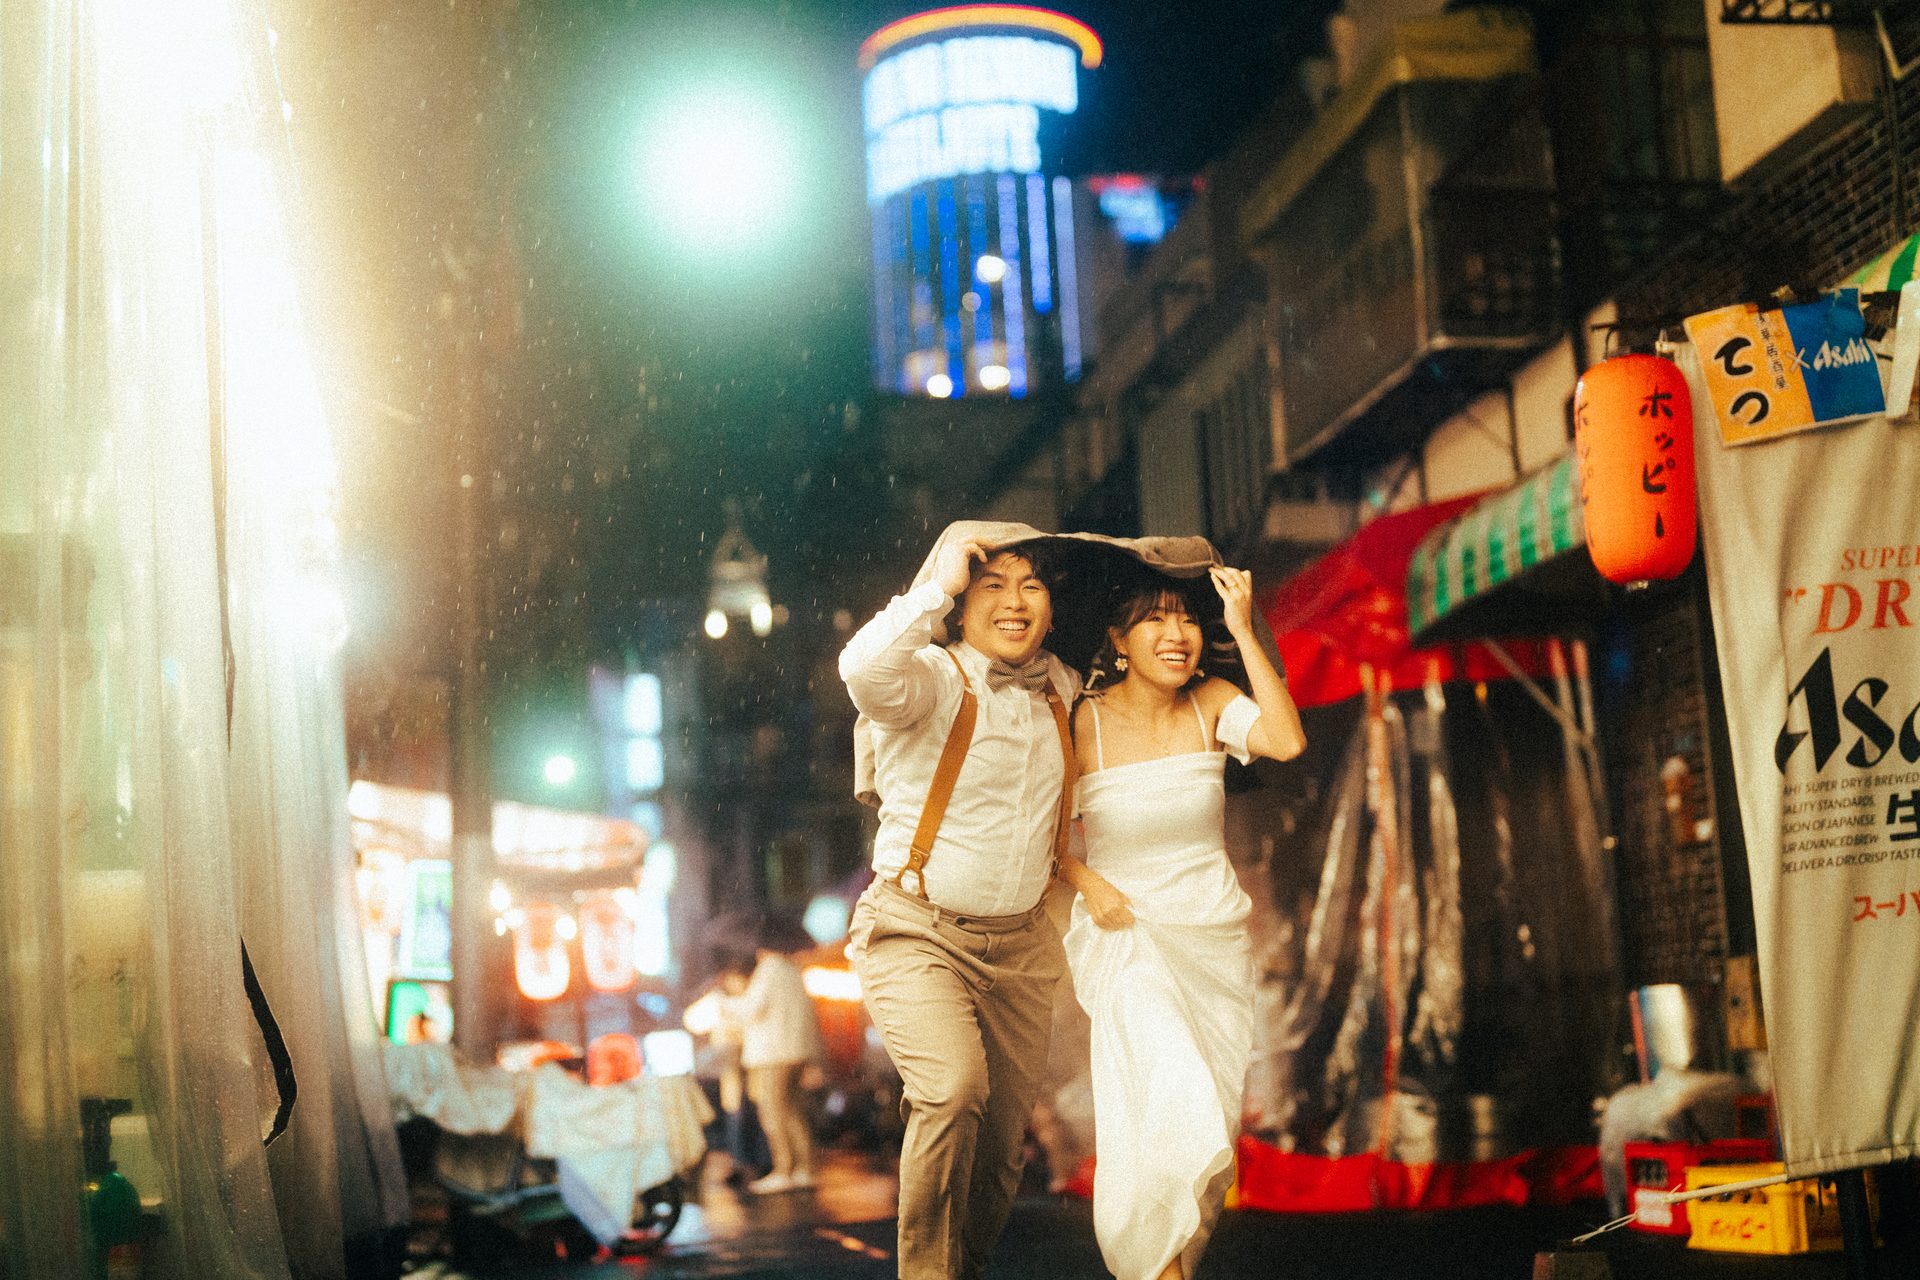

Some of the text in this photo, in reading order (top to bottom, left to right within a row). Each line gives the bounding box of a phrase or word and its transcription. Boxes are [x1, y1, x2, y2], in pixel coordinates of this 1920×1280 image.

[1714, 336, 1770, 424] てつ
[1813, 337, 1871, 372] Asahi
[1639, 386, 1676, 538] ホッピー
